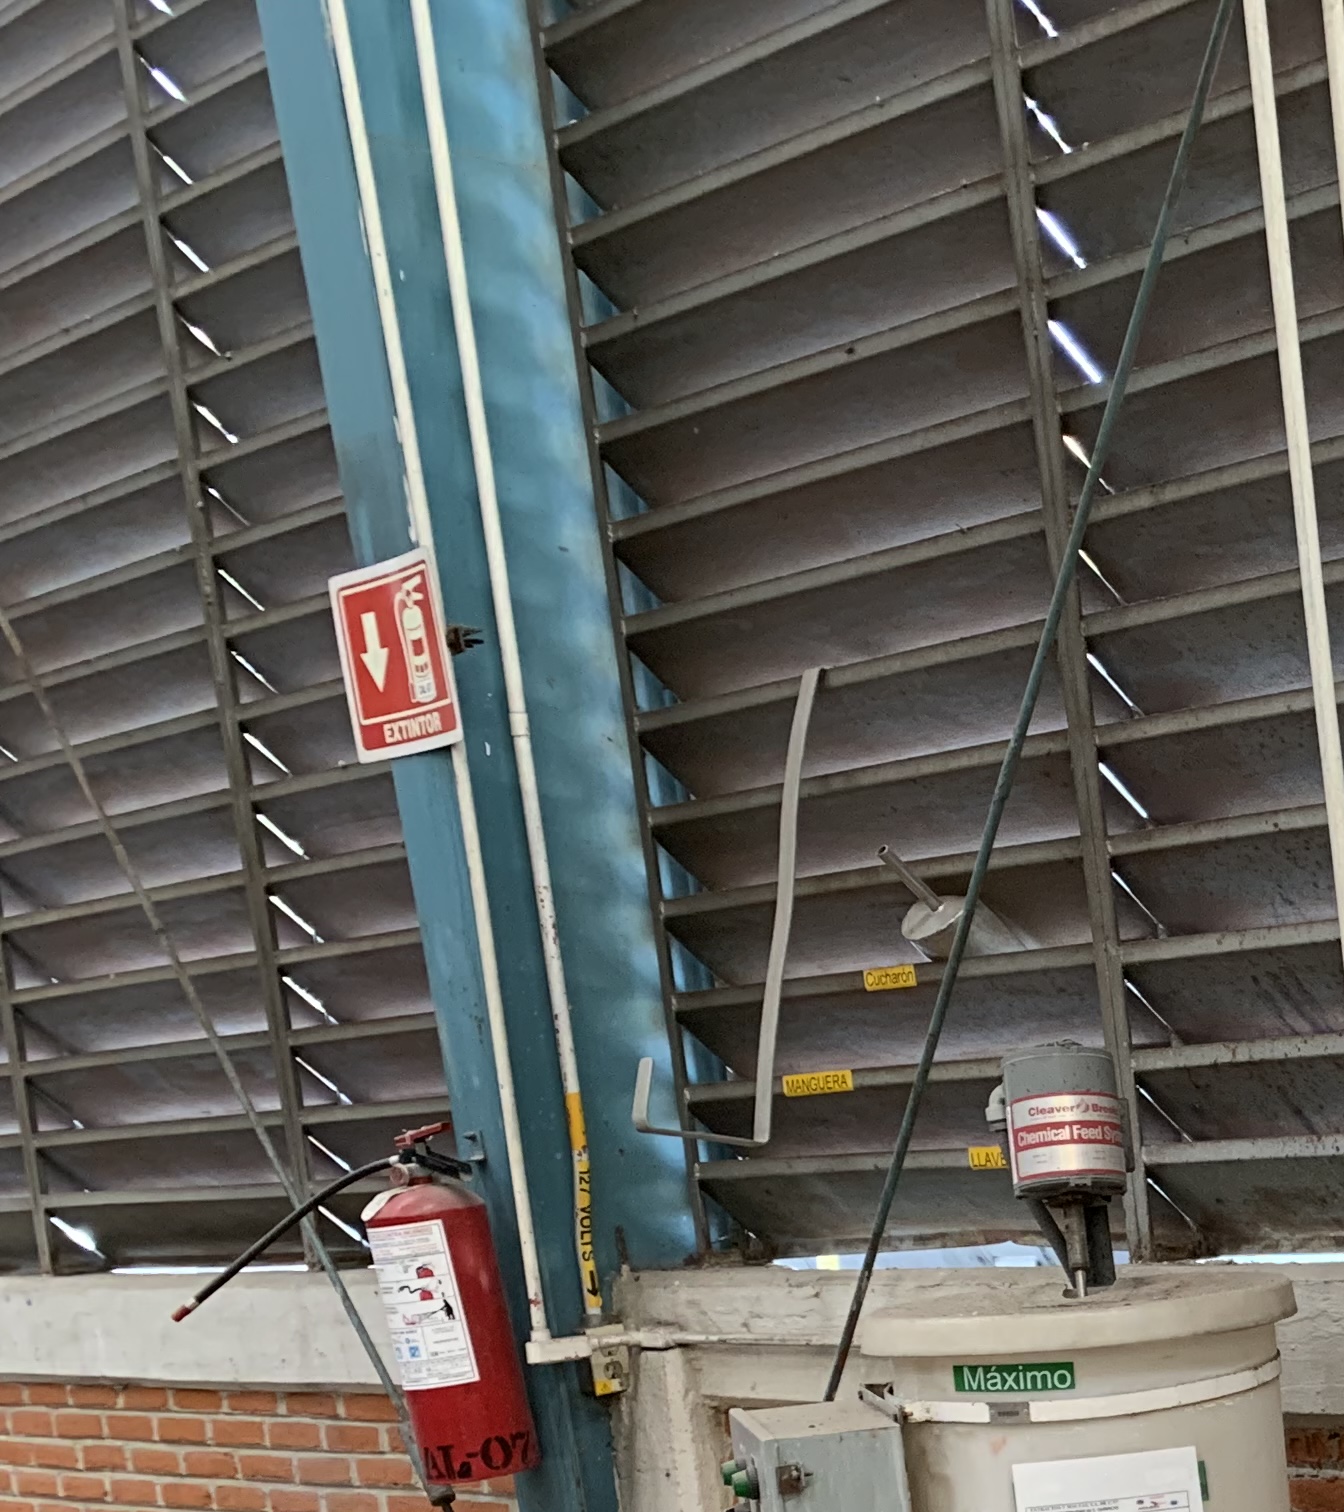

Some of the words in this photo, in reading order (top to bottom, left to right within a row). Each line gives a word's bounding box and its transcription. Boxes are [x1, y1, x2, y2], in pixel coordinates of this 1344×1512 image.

[383, 711, 442, 744] EXTINTOR
[865, 968, 914, 988] Cucharón
[785, 1074, 849, 1094] MANGUERA
[1028, 1104, 1075, 1117] Cleaver
[1017, 1125, 1070, 1147] Chemical
[1073, 1125, 1102, 1140] Feed
[962, 1365, 1072, 1391] Máximo
